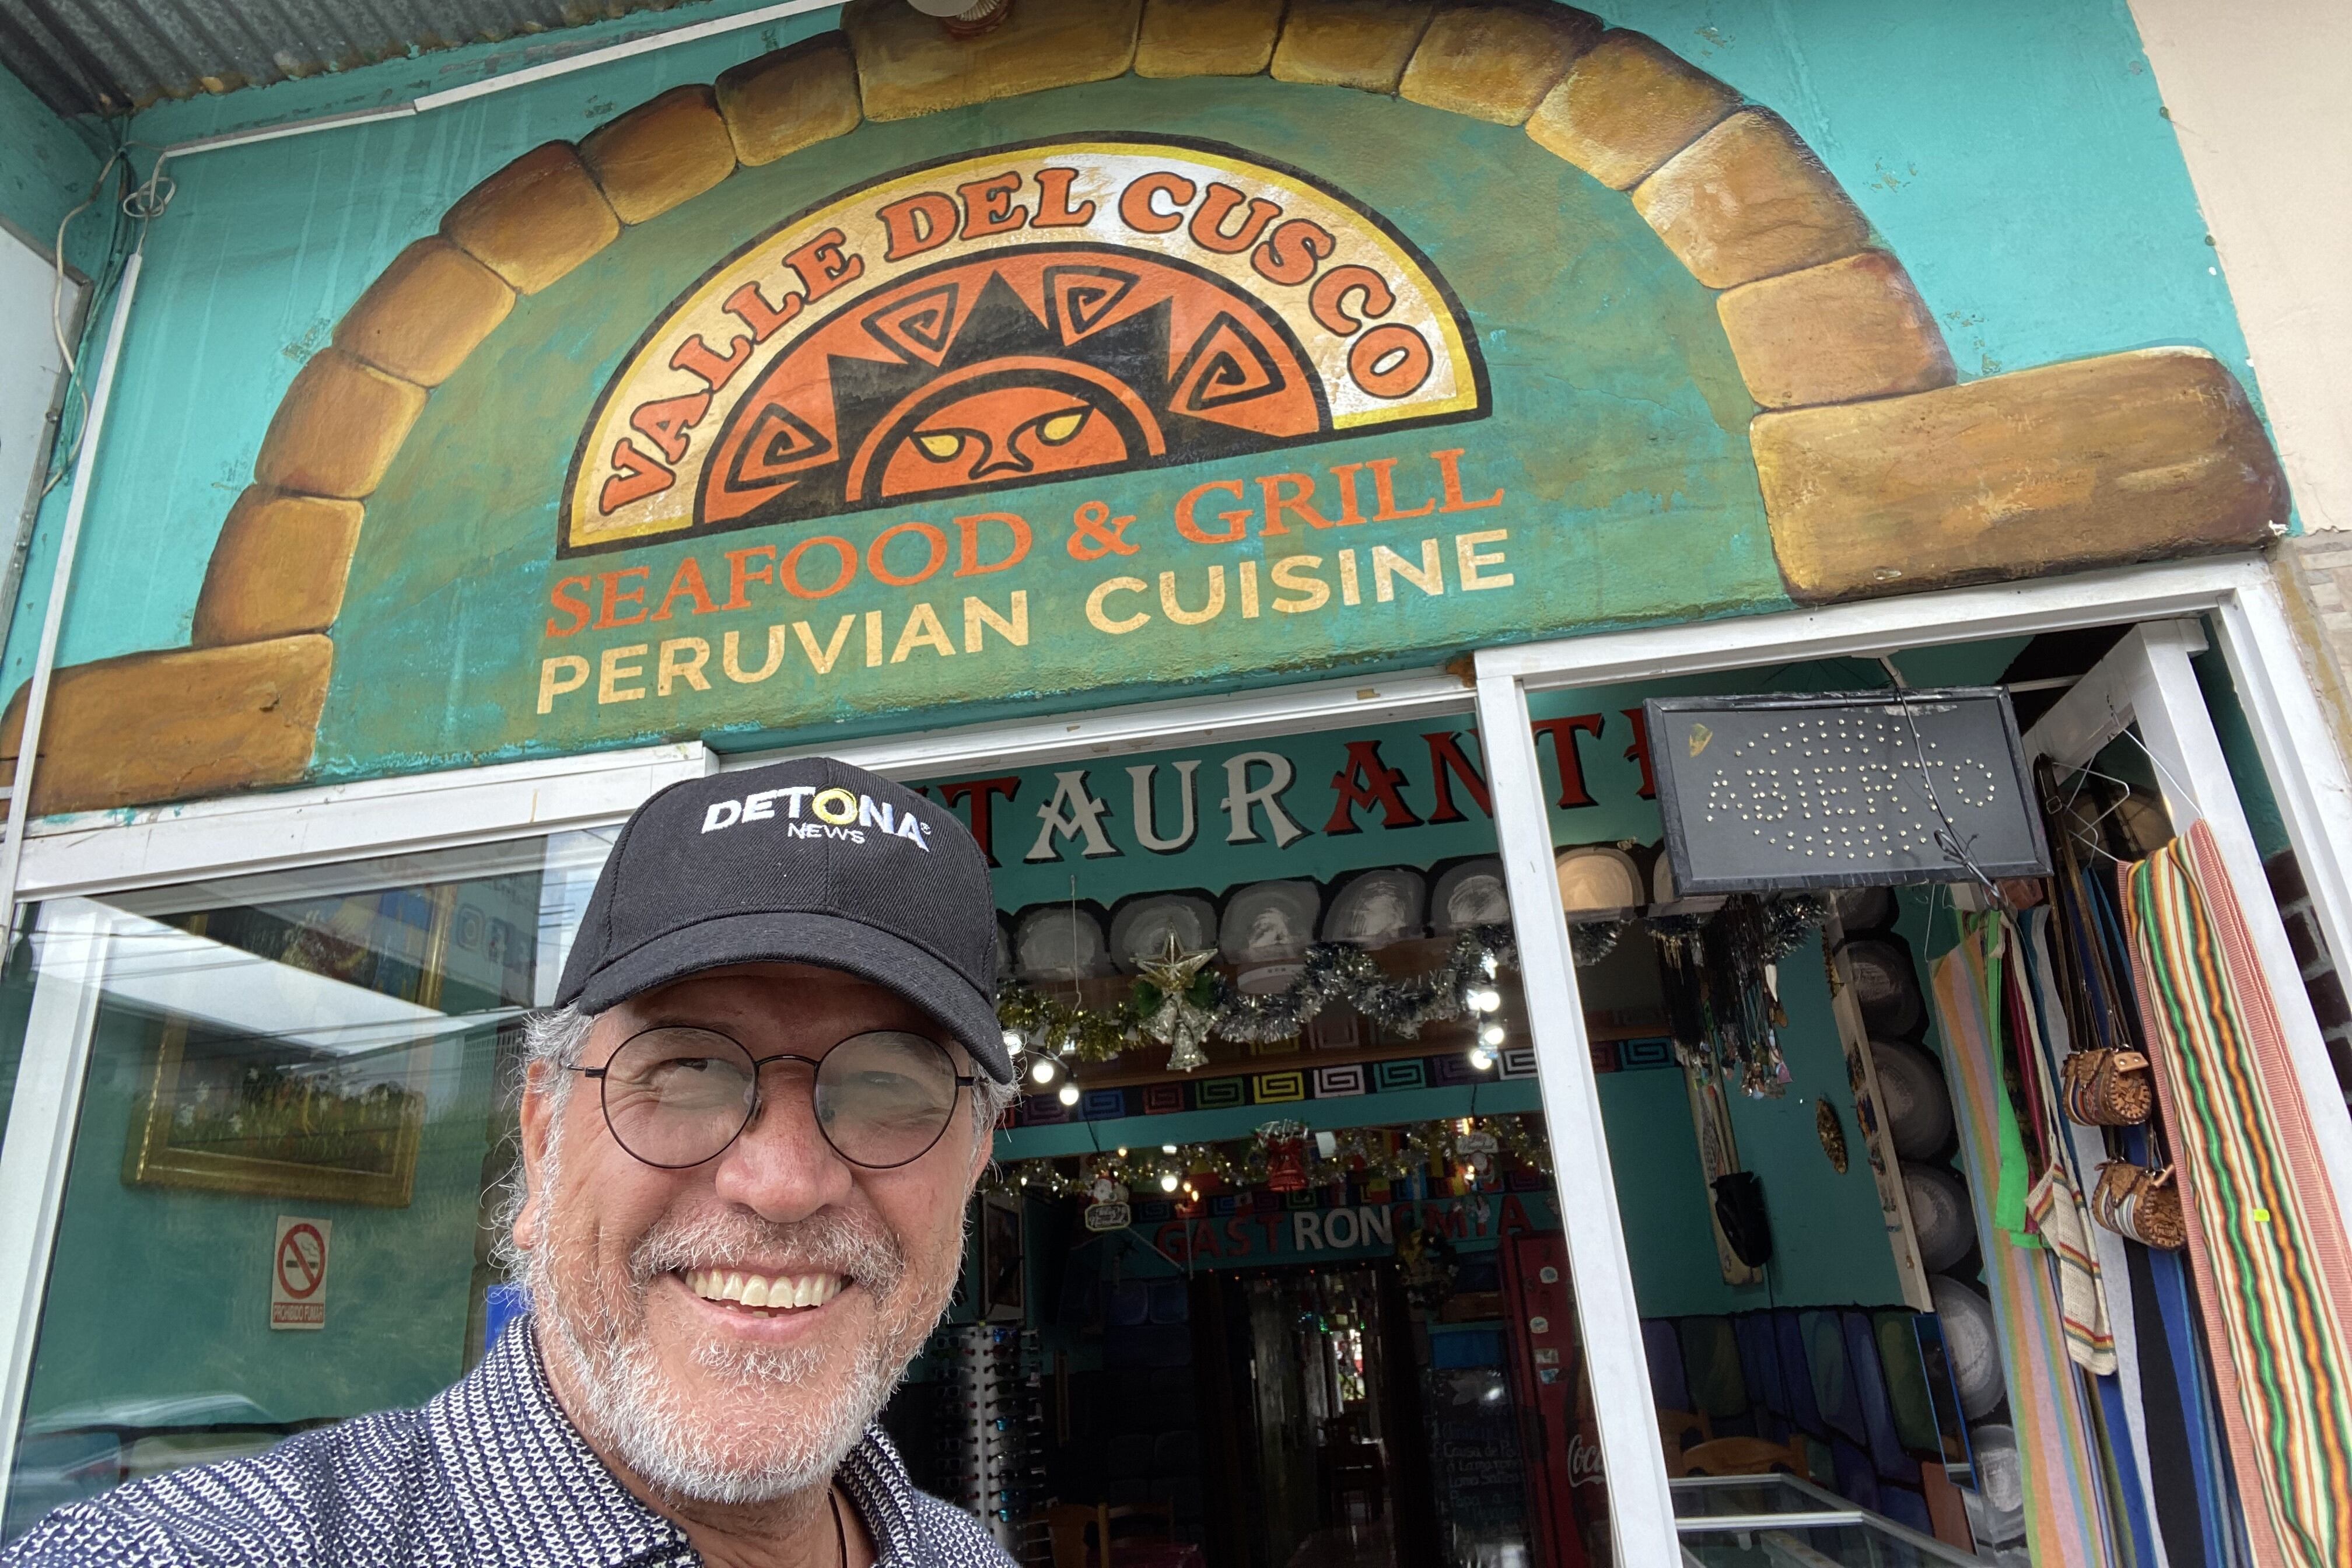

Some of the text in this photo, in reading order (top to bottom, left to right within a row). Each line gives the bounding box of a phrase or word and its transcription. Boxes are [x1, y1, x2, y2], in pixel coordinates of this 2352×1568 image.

[599, 167, 1434, 516] VALLE DEL CUSCO
[537, 528, 1514, 715] PERUVIAN CUISINE
[545, 448, 1505, 638] SEAFOOD & GRILL
[788, 822, 866, 845] NEWS
[936, 708, 1657, 868] TAURANT
[1706, 758, 1996, 824] ABIERTO
[274, 1304, 323, 1321] PROHIBIDO FUMAR
